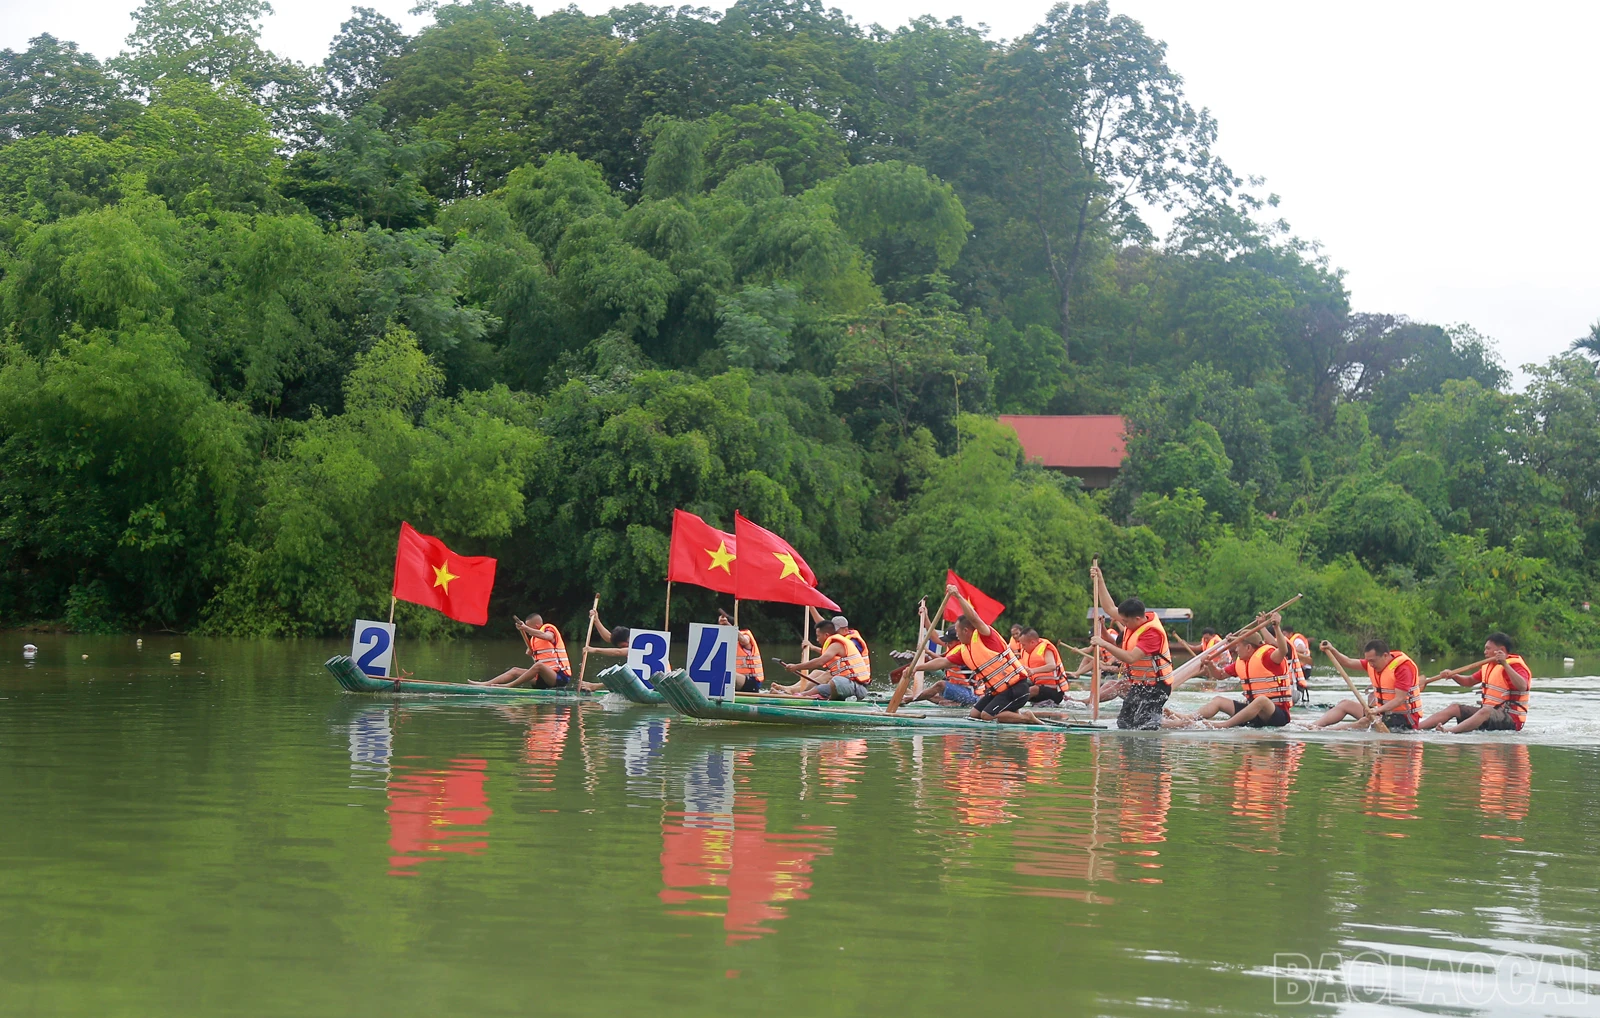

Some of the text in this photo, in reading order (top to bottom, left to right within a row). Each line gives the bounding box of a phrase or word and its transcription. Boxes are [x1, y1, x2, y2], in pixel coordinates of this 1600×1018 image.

[357, 626, 390, 676] 2
[631, 633, 667, 690] 3
[689, 627, 732, 697] 4
